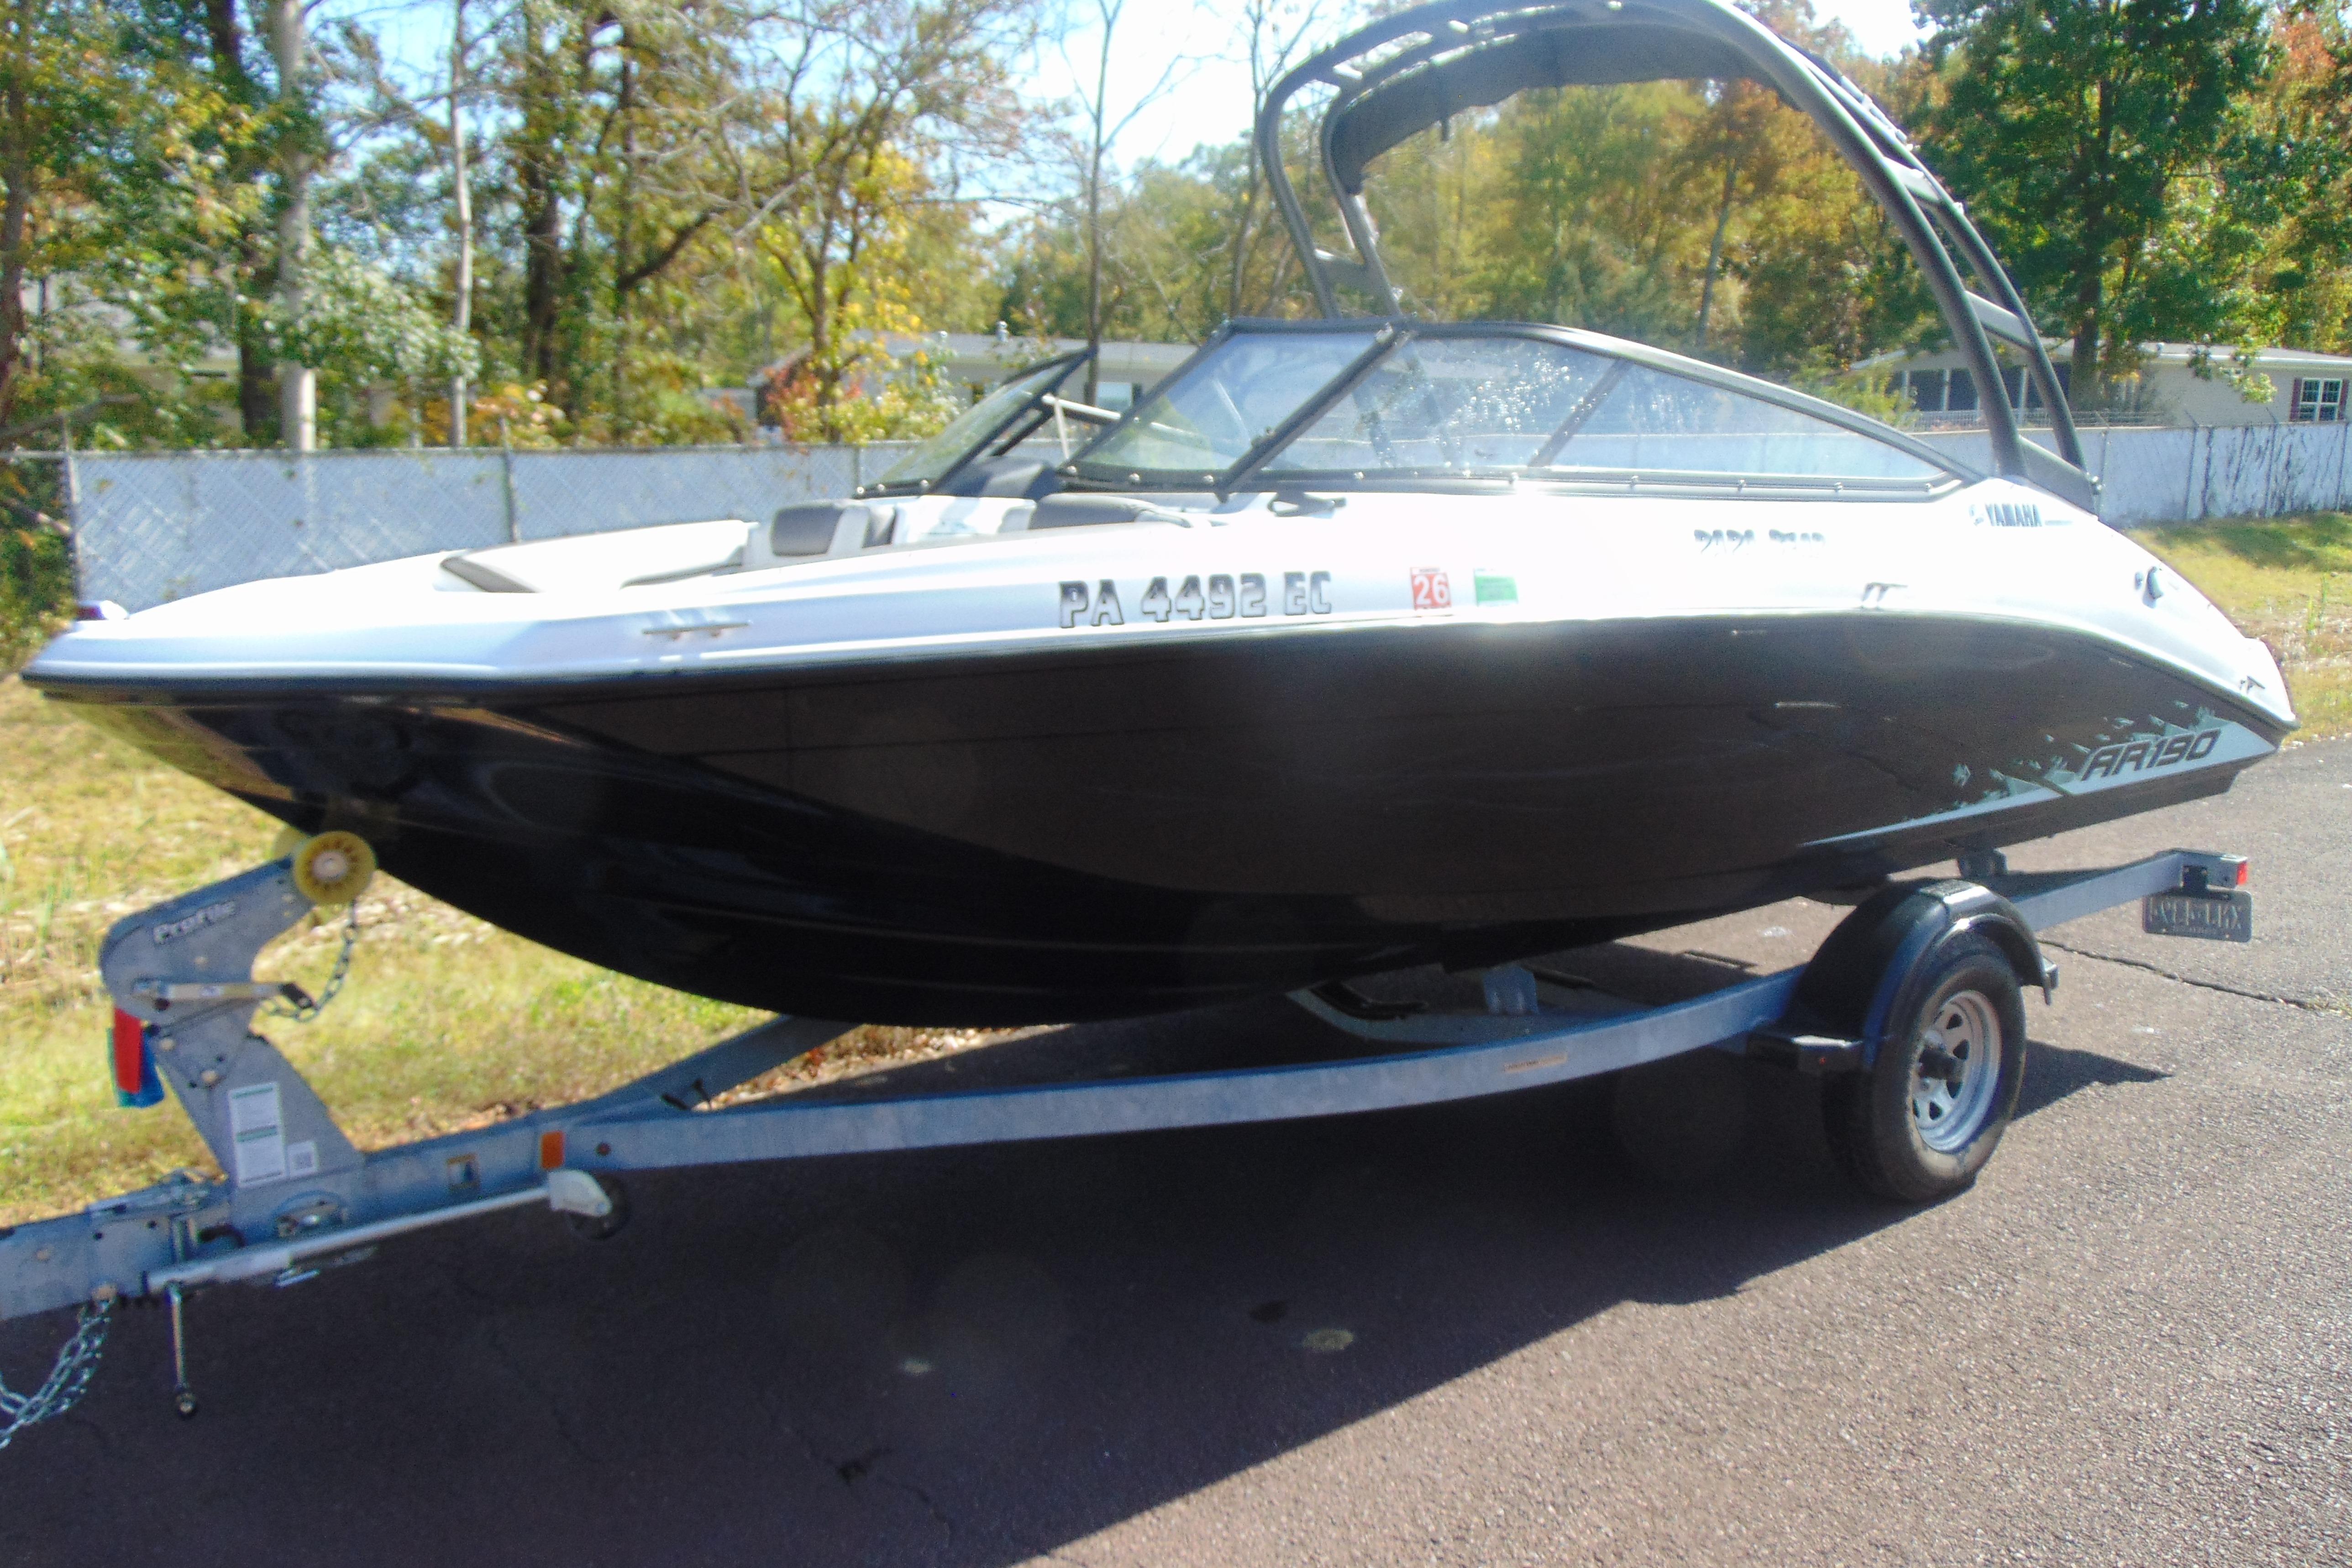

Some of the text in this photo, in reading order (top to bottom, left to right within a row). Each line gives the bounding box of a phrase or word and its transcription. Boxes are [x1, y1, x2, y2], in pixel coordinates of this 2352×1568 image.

[1985, 503, 2042, 527] YAMAHA
[1058, 570, 1332, 629] PA 4492 EC
[1414, 574, 1449, 605] 26
[2080, 728, 2221, 781] AR190
